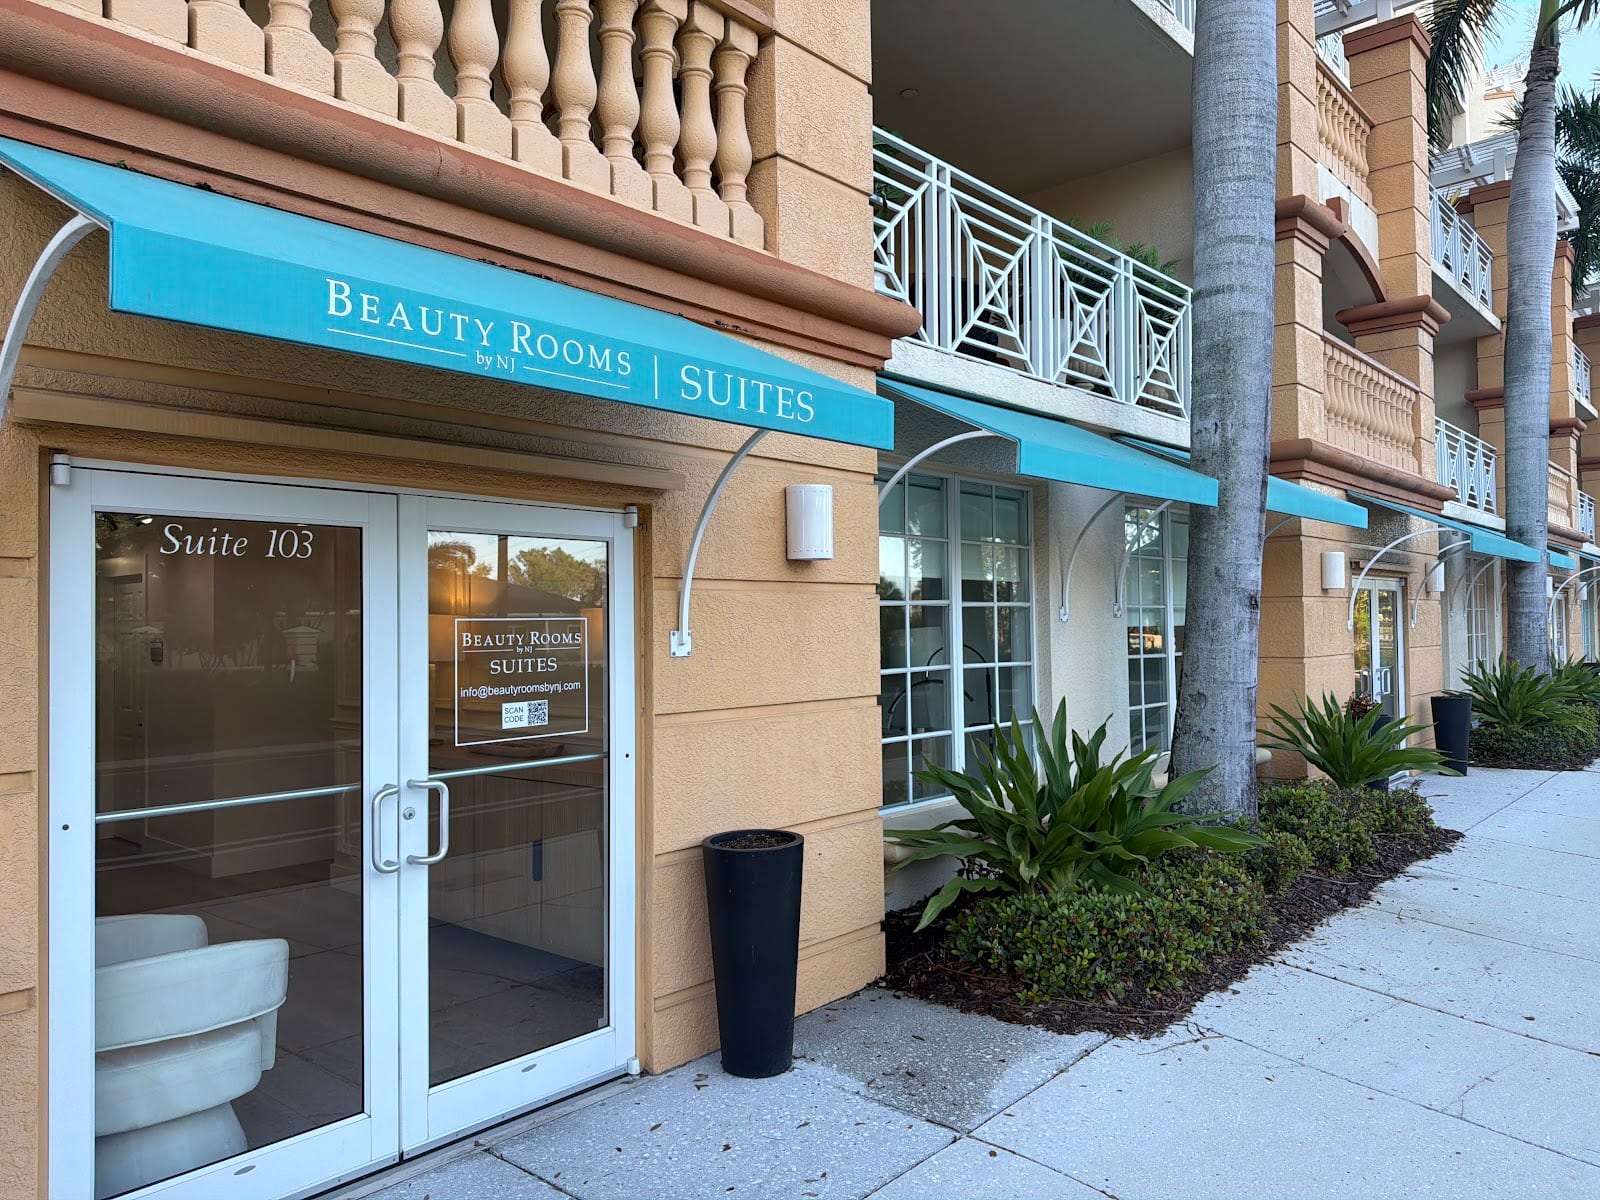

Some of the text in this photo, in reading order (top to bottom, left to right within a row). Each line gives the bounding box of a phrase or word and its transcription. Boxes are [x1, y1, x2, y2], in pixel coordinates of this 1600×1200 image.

[325, 277, 815, 423] BEAUTY ROOMS SUITES
[475, 350, 516, 374] by NJ
[160, 523, 314, 559] Suite 103
[462, 631, 582, 647] BEAUTY ROOMS
[490, 657, 558, 674] SUITES
[460, 681, 581, 699] info@beautyroomsbynj.com
[504, 706, 524, 715] SCAN
[504, 715, 524, 723] CODE
